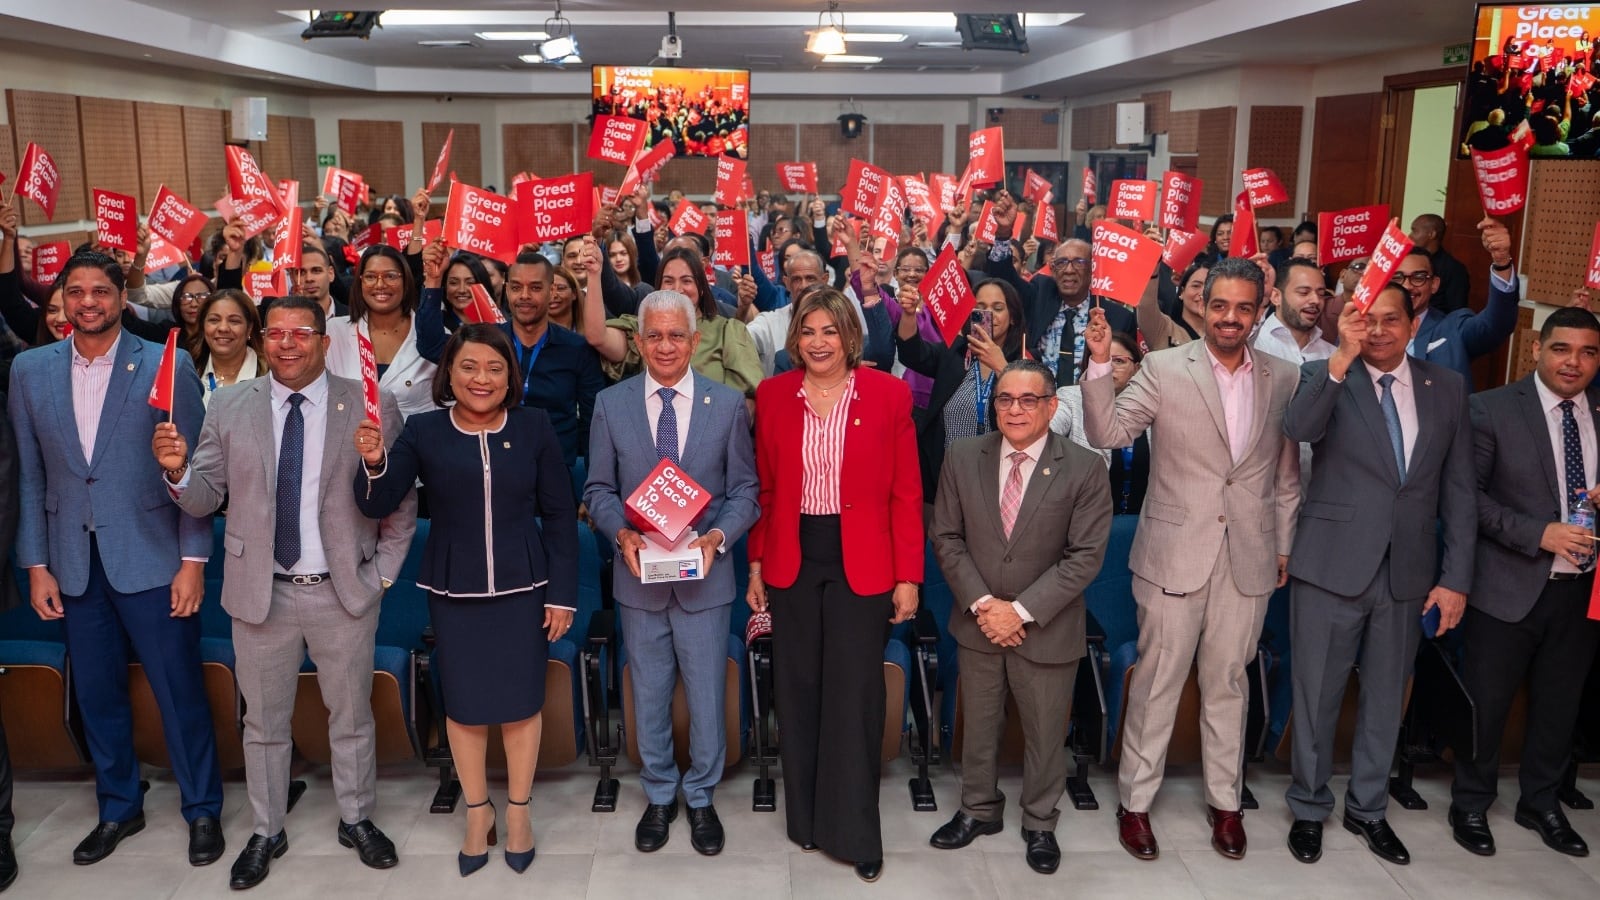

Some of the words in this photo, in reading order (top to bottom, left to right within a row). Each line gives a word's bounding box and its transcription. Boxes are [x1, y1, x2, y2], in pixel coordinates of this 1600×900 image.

[1517, 7, 1590, 21] Great
[1515, 21, 1583, 39] Place
[614, 76, 651, 87] Place
[606, 119, 636, 132] Great
[602, 137, 614, 147] To
[604, 128, 632, 141] Place
[970, 134, 986, 148] eat
[33, 161, 54, 189] Place
[240, 161, 260, 176] Pla
[861, 167, 881, 183] Grea
[970, 169, 988, 181] ork.
[1477, 168, 1518, 183] Place
[29, 171, 42, 186] To
[240, 173, 256, 184] To
[859, 178, 878, 193] Plac
[533, 182, 575, 197] Great
[856, 189, 867, 201] To
[1118, 191, 1143, 200] Place
[1119, 183, 1146, 193] Great
[98, 194, 125, 210] Great
[165, 195, 195, 219] Great
[465, 191, 508, 214] Great
[534, 197, 574, 211] Place
[854, 200, 873, 216] Wor
[883, 195, 903, 220] Pla
[1117, 200, 1127, 208] To
[1165, 201, 1178, 212] To
[97, 206, 124, 222] Place
[155, 210, 166, 222] To
[160, 202, 187, 225] Place
[461, 204, 502, 226] Place
[535, 212, 551, 225] To
[716, 215, 733, 226] reat
[878, 206, 893, 221] To
[1333, 211, 1370, 226] Great
[97, 218, 110, 230] To
[460, 217, 476, 232] To
[1333, 224, 1367, 237] Place
[715, 228, 732, 237] lace
[1094, 226, 1138, 250] Great
[1332, 237, 1346, 247] To
[1381, 232, 1405, 258] reat
[714, 250, 734, 261] ork.
[1092, 241, 1128, 262] Place
[1372, 251, 1392, 273] ace
[948, 260, 967, 298] Great
[1091, 276, 1114, 291] ork.
[934, 278, 943, 296] To
[941, 269, 959, 305] Place
[662, 466, 699, 499] Great
[645, 485, 659, 503] To
[653, 475, 687, 508] Place
